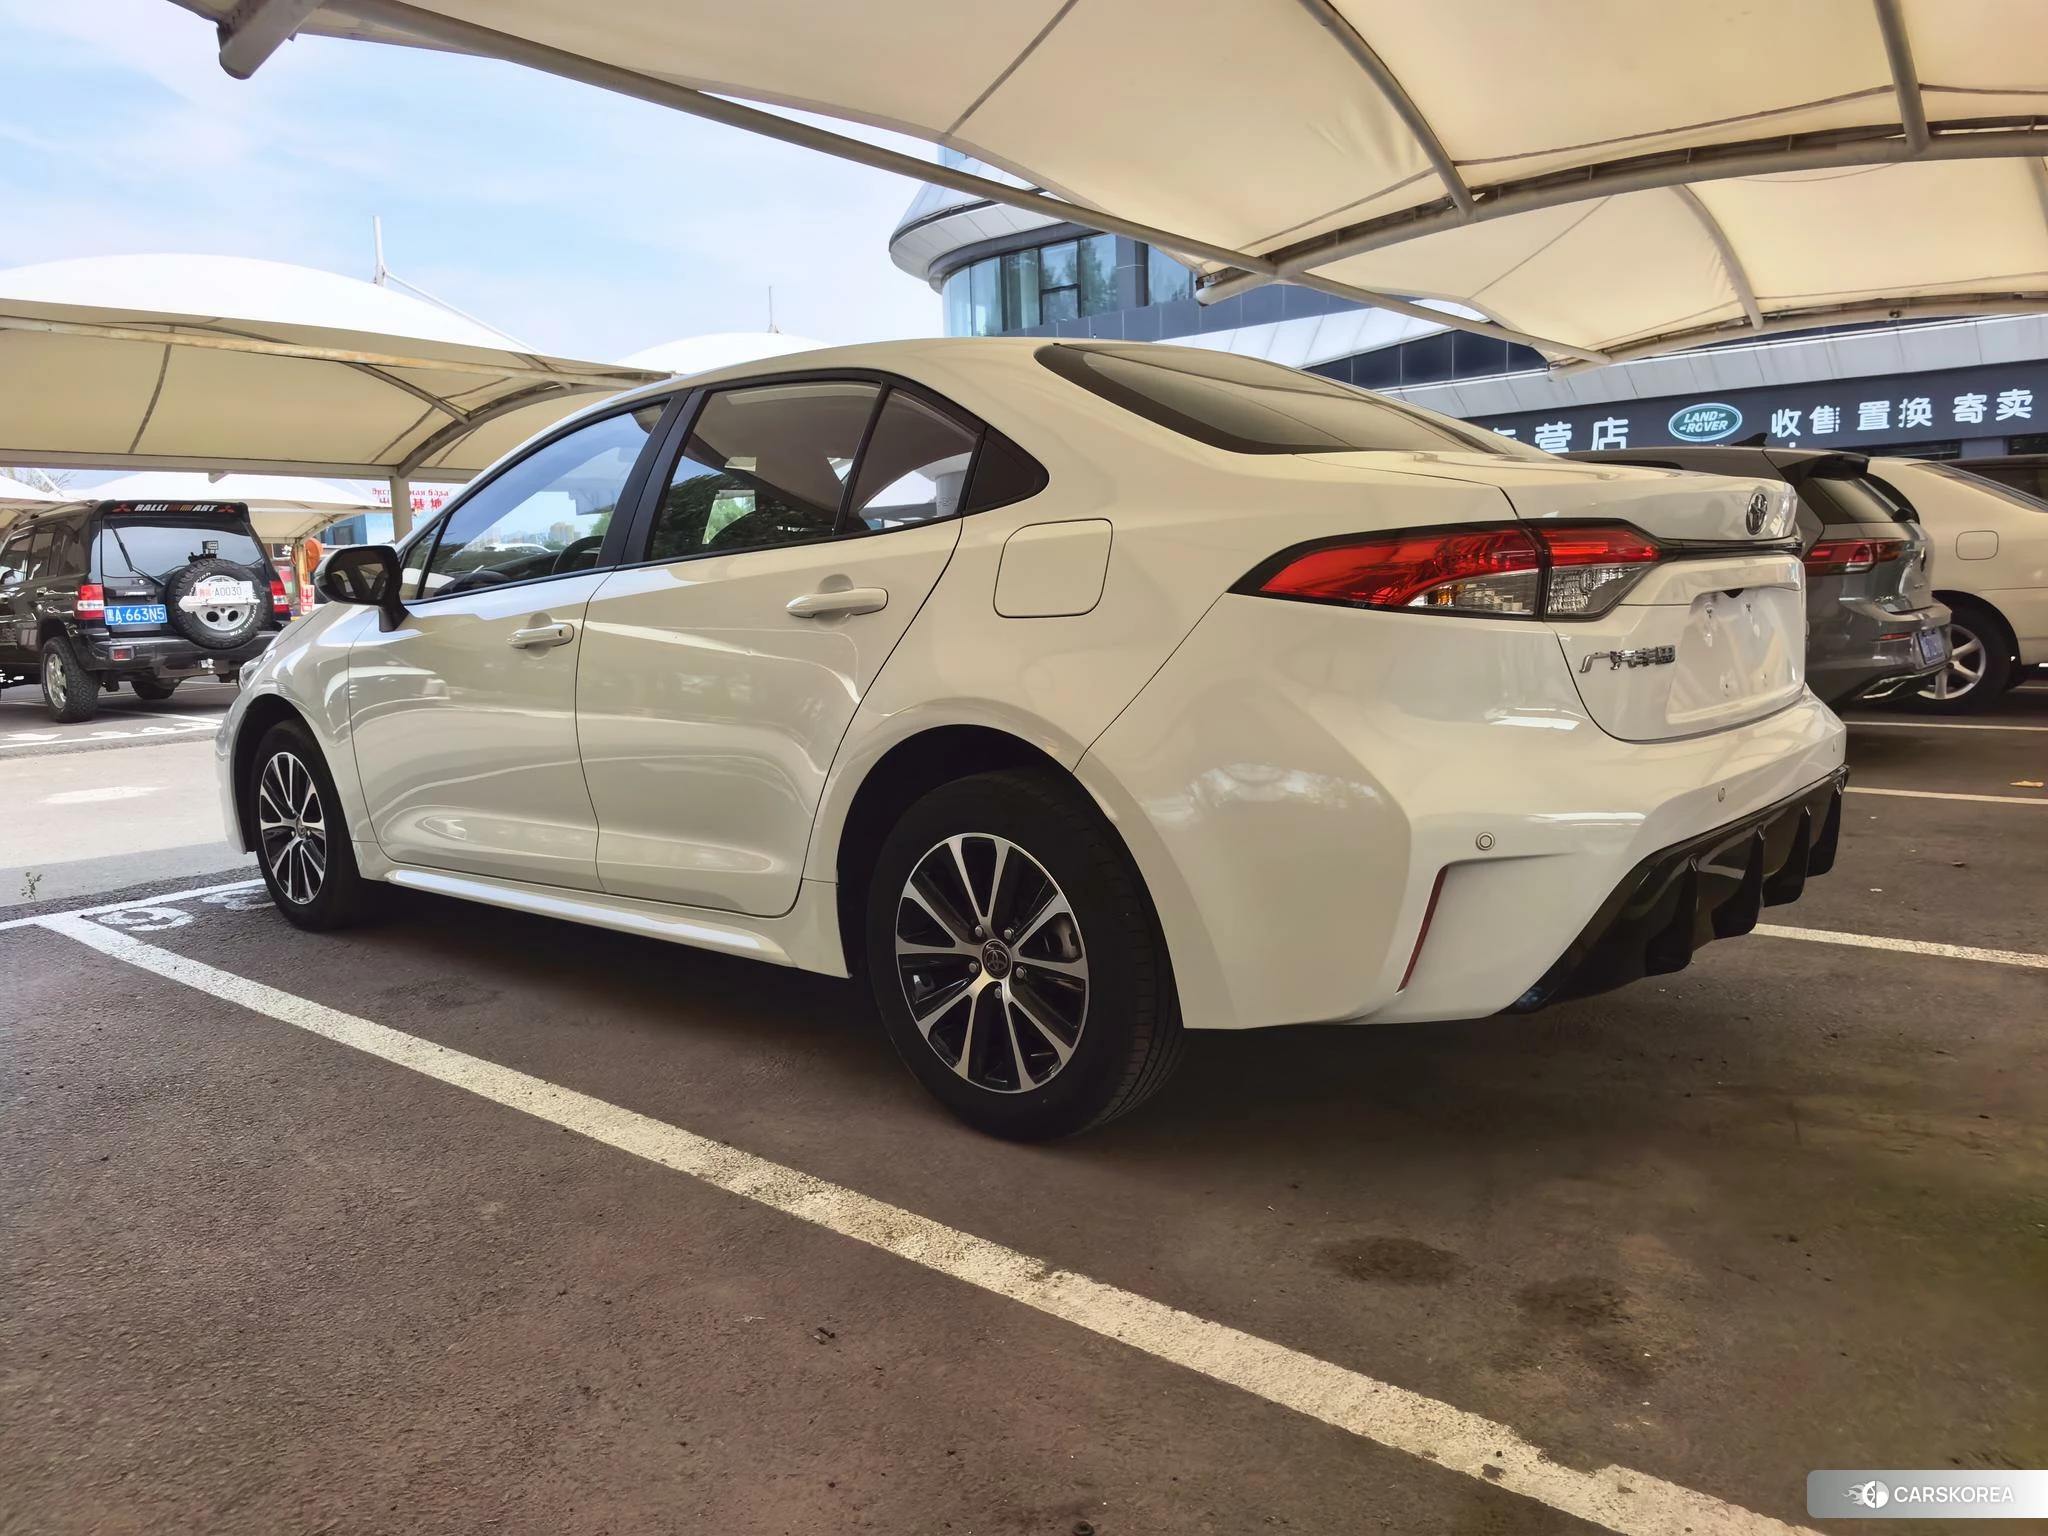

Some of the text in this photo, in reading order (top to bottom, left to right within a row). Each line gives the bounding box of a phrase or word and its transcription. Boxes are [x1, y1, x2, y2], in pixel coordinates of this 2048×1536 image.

[1857, 397, 1933, 431] 置换
[1953, 388, 2033, 424] 寄卖
[1683, 411, 1717, 423] LAND
[1687, 420, 1728, 433] ROVER
[1493, 417, 1629, 453] 营店
[134, 504, 218, 512] RALLI ART
